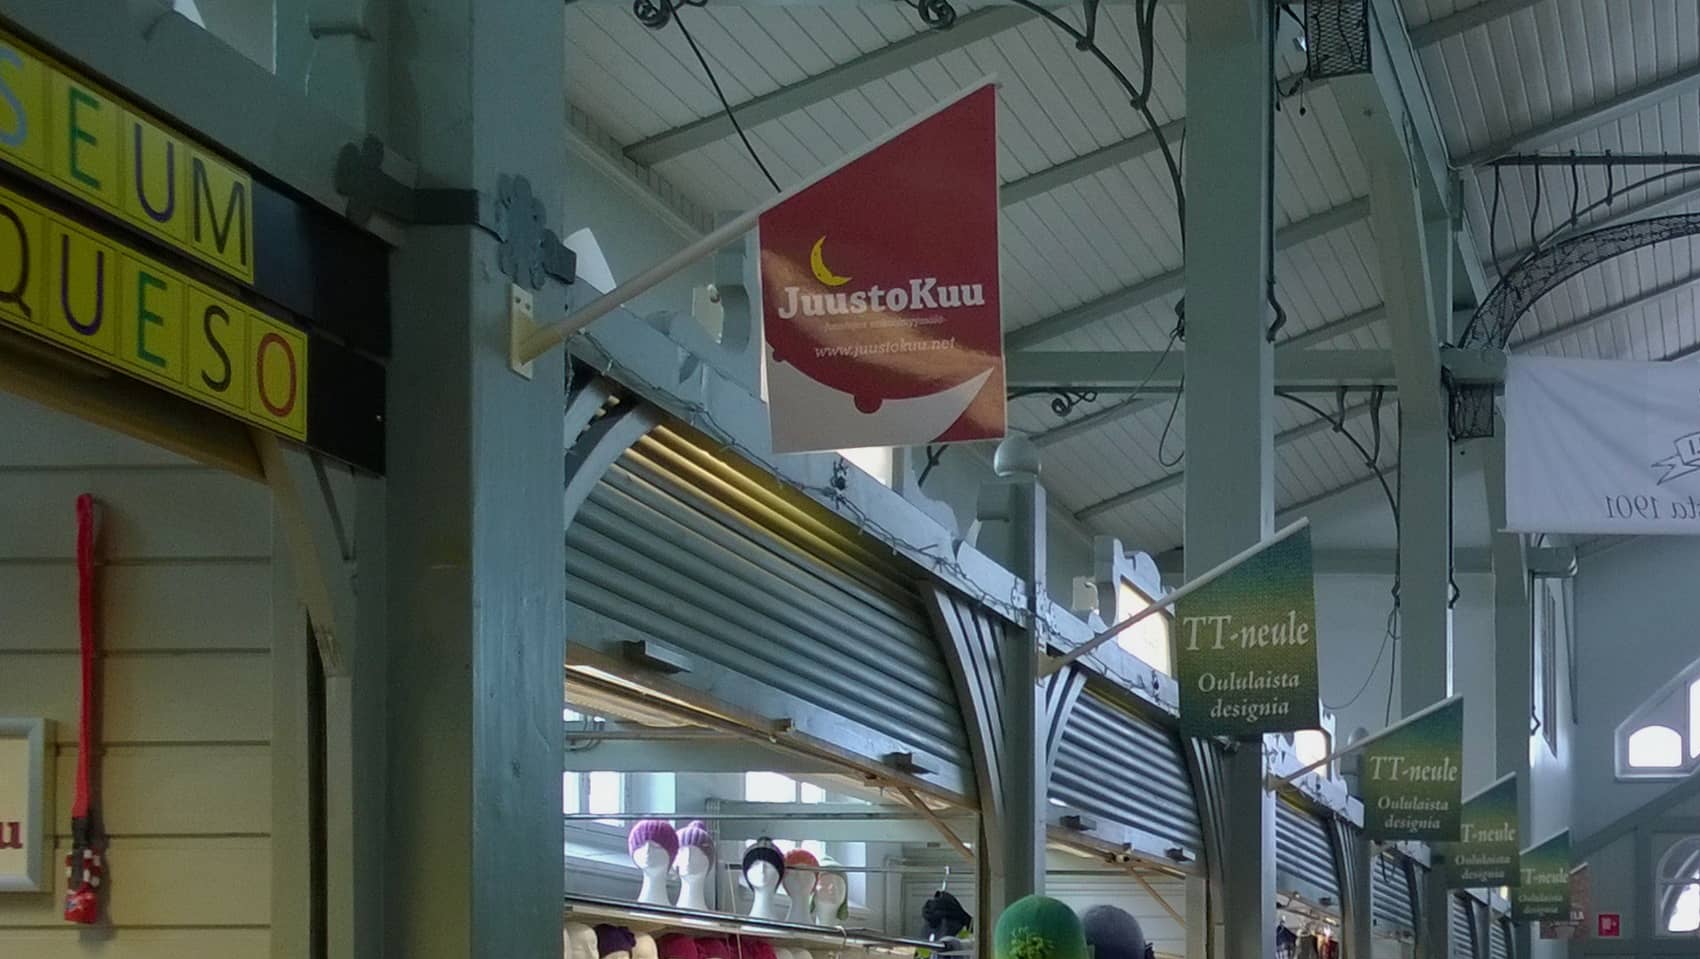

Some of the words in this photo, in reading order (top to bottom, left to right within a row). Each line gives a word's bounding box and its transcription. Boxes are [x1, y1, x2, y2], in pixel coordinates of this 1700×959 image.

[778, 278, 985, 319] JuustoKuu
[815, 337, 956, 360] www.juustokuu.net
[1182, 610, 1310, 651] TT-neule
[1198, 671, 1300, 692] Oululaista
[1210, 697, 1290, 722] designia
[1369, 756, 1459, 782] TT-neule
[1377, 795, 1450, 811] Oululaista
[1384, 814, 1442, 833] designia
